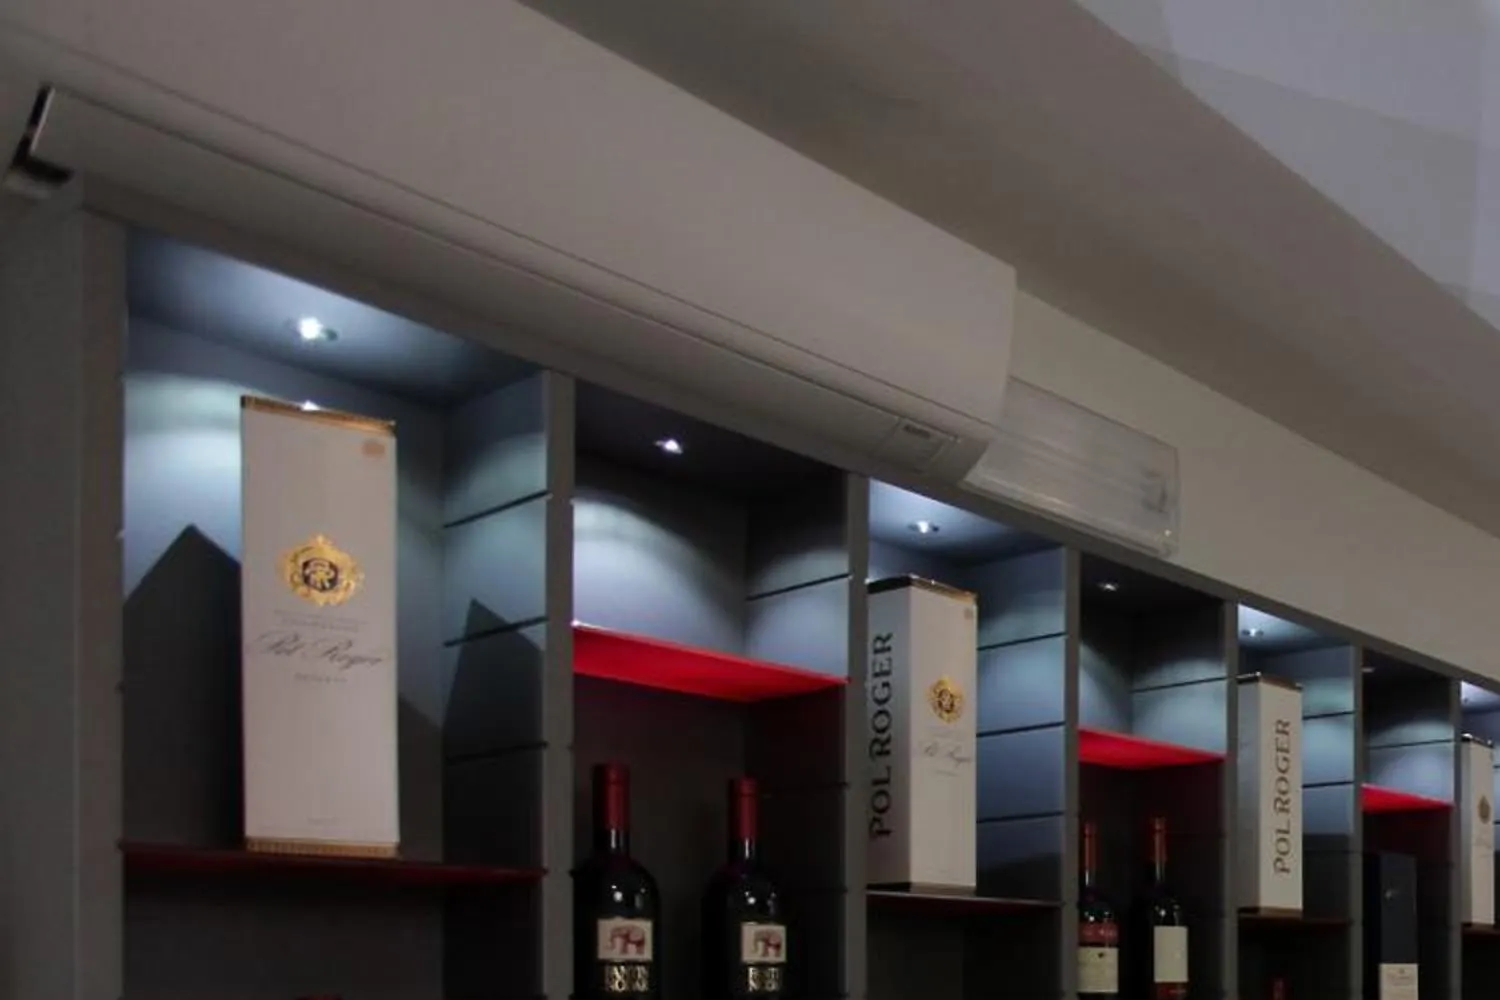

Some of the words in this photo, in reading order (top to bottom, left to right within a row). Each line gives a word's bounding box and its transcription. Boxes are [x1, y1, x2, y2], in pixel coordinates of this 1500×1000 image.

[869, 632, 893, 762] ROGER
[869, 766, 892, 839] POL
[1273, 719, 1291, 815] ROGER
[1273, 819, 1291, 875] POL
